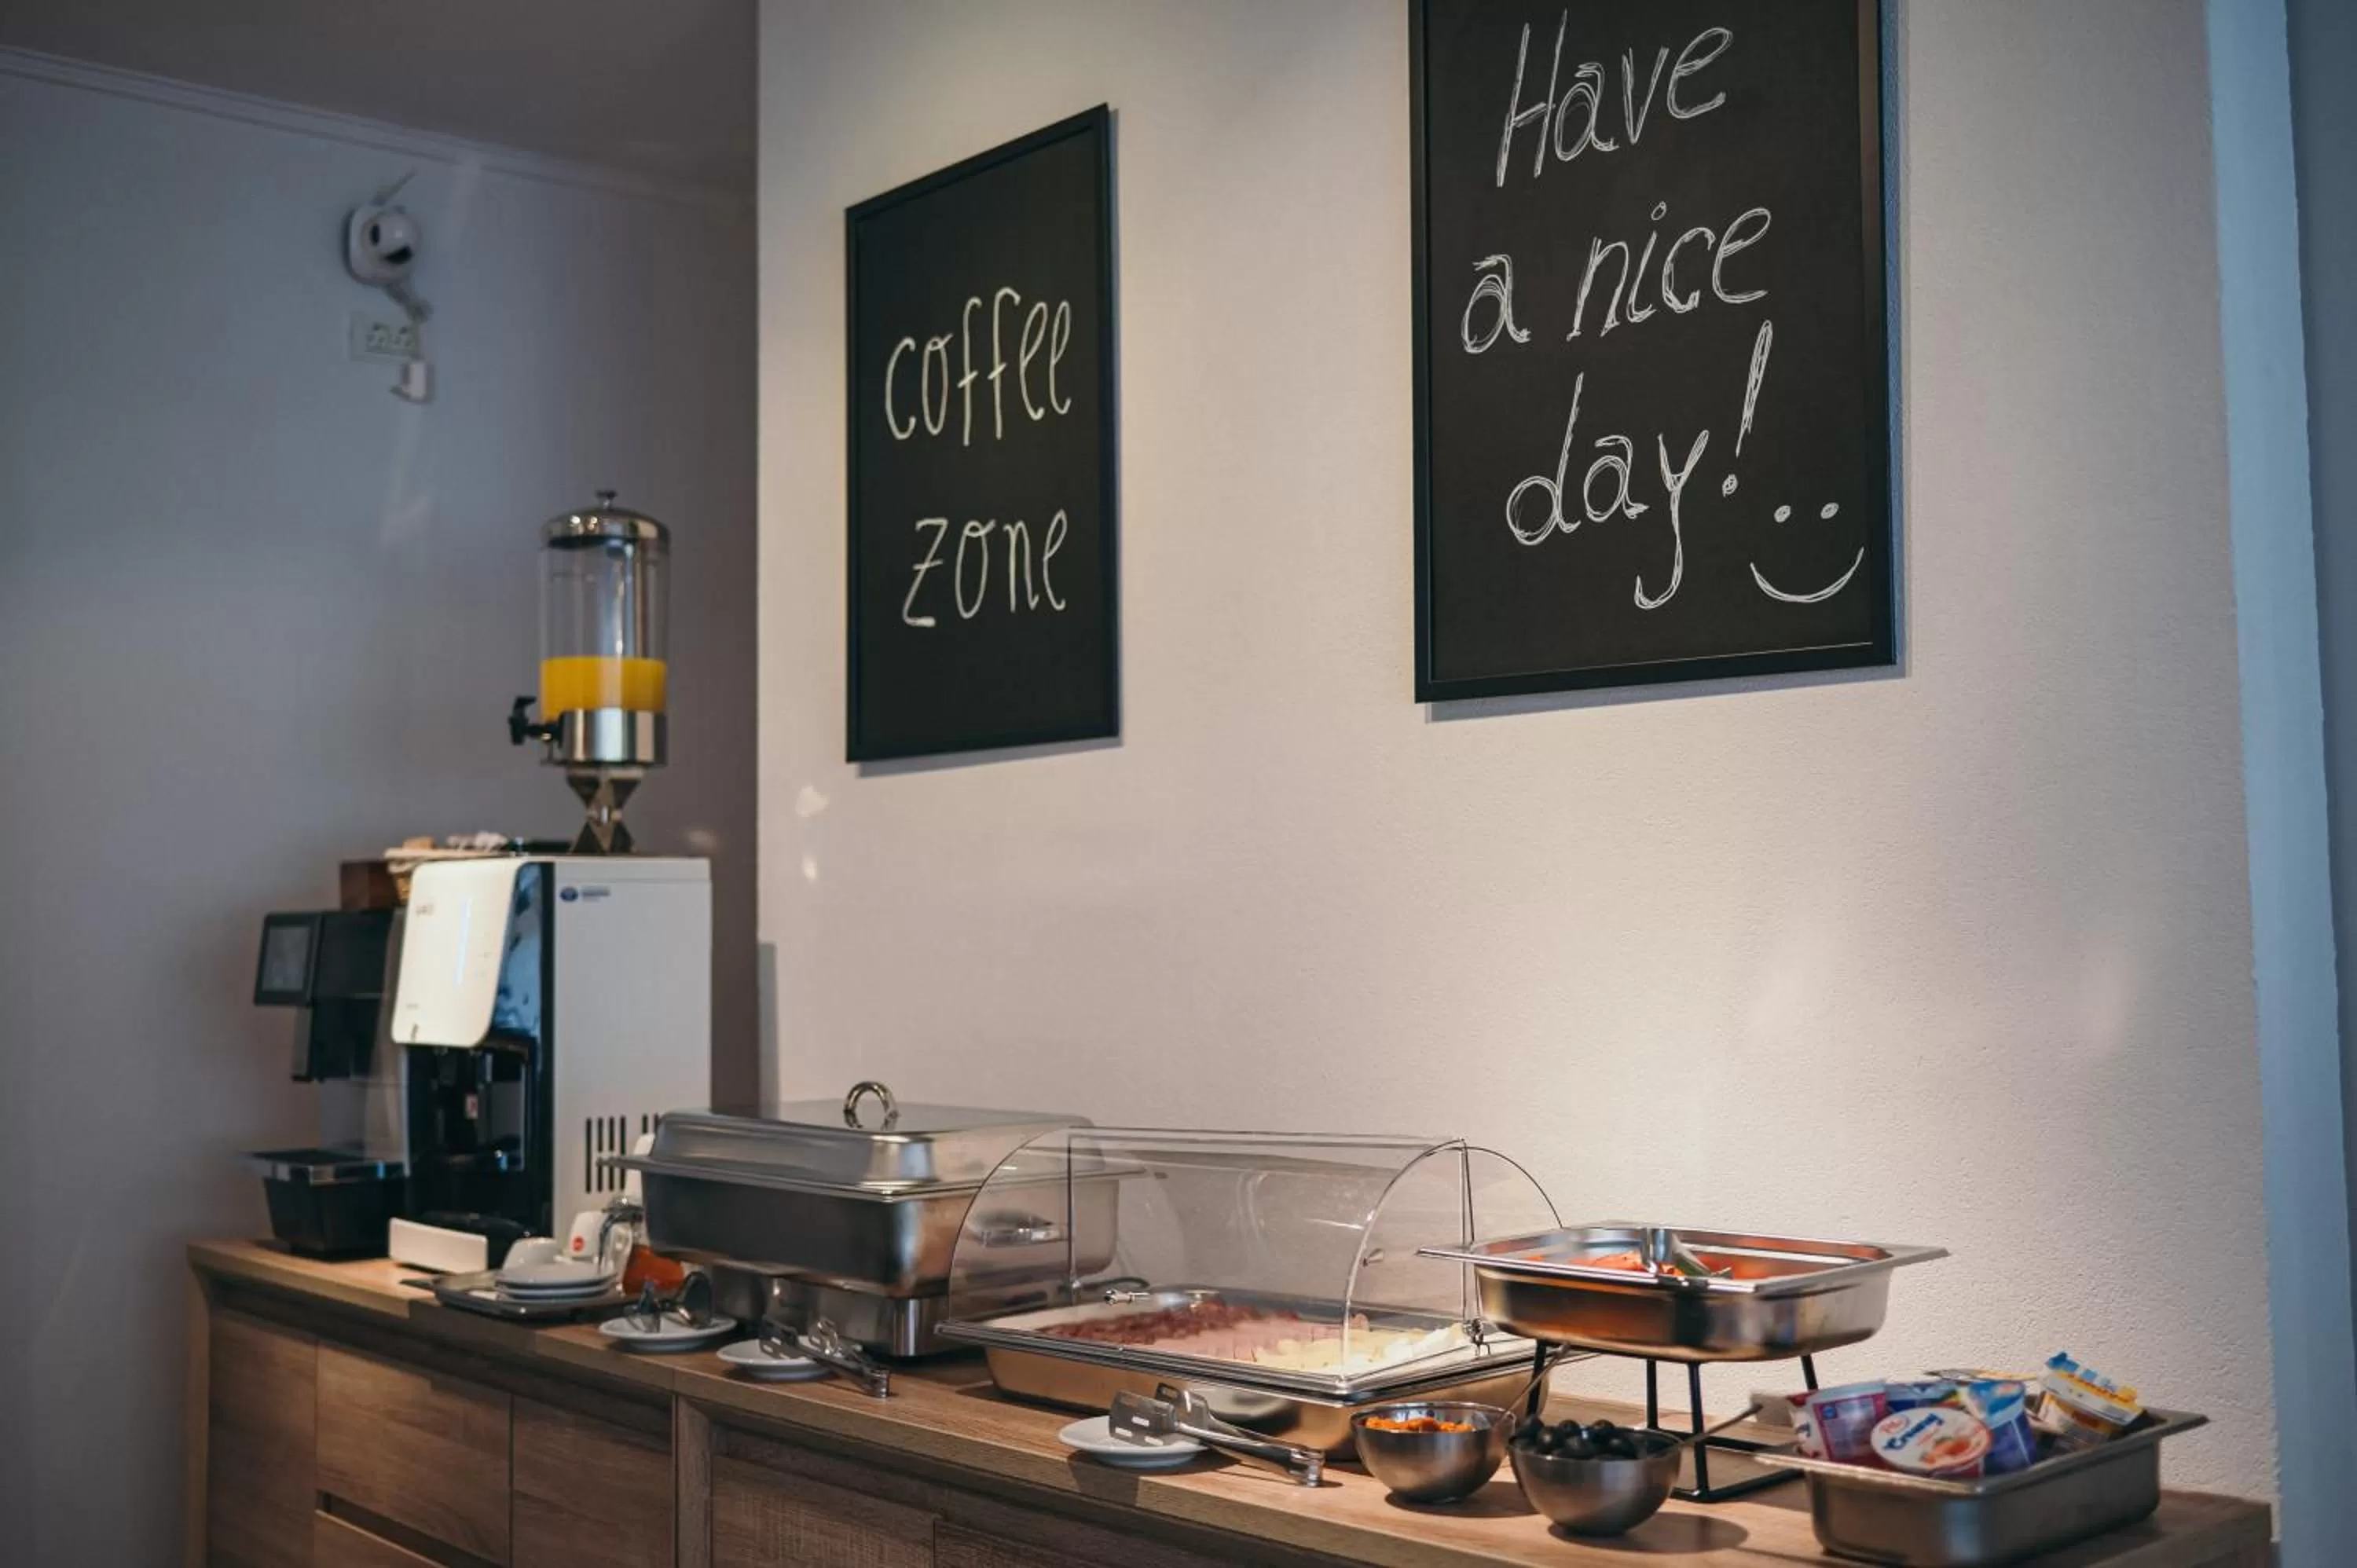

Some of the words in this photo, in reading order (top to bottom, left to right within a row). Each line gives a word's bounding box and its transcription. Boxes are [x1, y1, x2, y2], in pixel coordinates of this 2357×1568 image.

[1496, 9, 1733, 189] Have
[1461, 254, 1531, 354] a
[1566, 200, 1772, 342] nice
[885, 287, 1072, 447] coffee
[1505, 320, 1774, 610] day!
[903, 509, 1068, 628] zone
